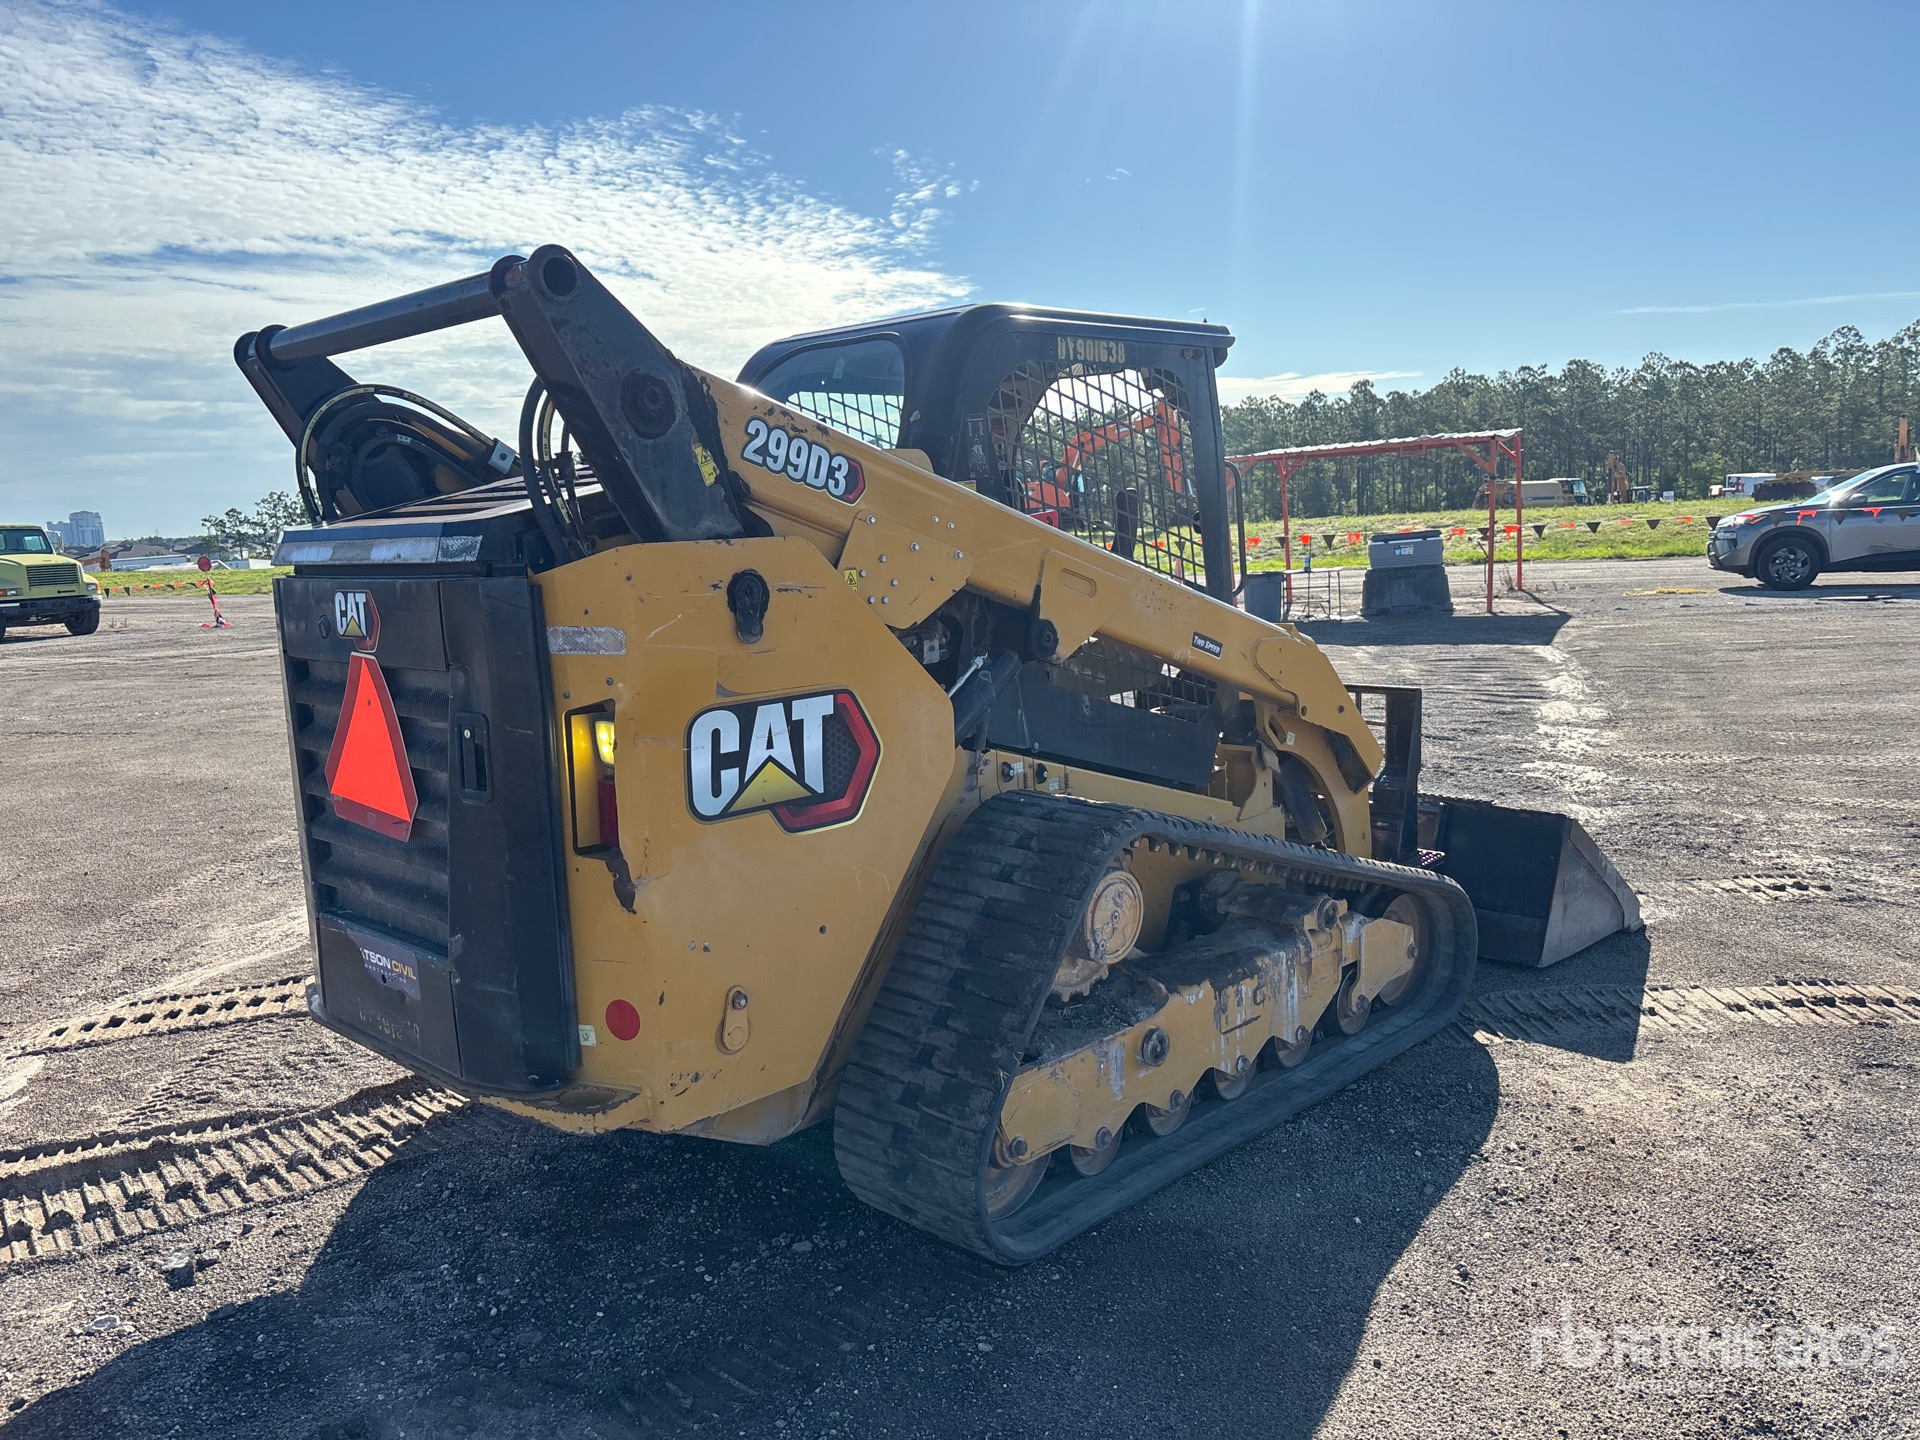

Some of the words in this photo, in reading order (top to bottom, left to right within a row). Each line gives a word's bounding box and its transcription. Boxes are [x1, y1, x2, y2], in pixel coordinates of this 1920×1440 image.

[1057, 336, 1126, 364] DY901638
[743, 419, 849, 496] 299D3
[334, 592, 367, 636] CAT
[691, 694, 834, 816] CAT
[391, 960, 417, 980] CIVIL
